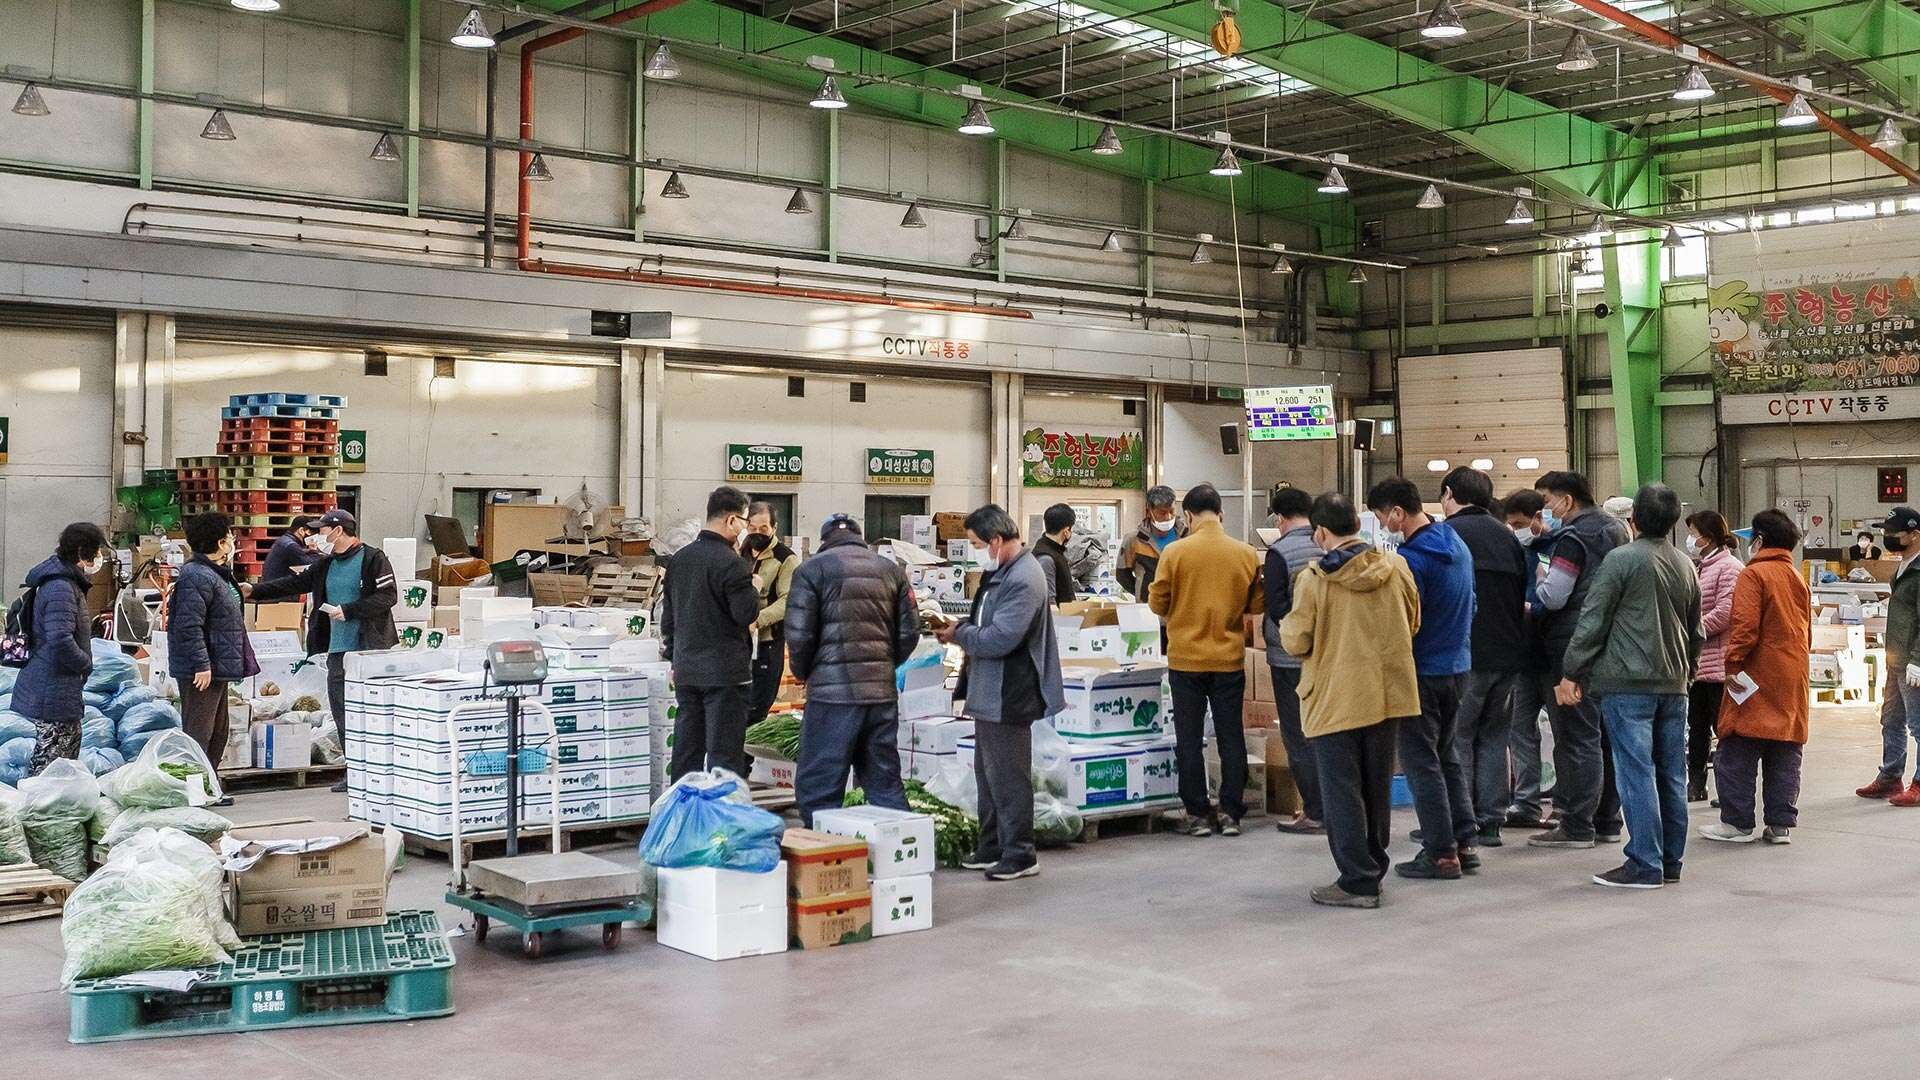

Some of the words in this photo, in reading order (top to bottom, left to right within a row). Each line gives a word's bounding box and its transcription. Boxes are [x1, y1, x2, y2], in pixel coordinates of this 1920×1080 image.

[1762, 284, 1894, 325] 주형농산
[1728, 364, 1803, 382] 주문전화:
[1308, 396, 1322, 404] 251
[1768, 399, 1833, 416] CCTV
[1839, 395, 1890, 413] 작동중
[347, 444, 362, 455] 213
[1043, 432, 1121, 468] 주형농산
[746, 455, 787, 472] 강원농산
[884, 458, 919, 473] 대성상회
[921, 461, 932, 471] 216
[894, 847, 918, 863] 오이
[281, 902, 336, 924] 순쌀떡
[891, 905, 915, 921] 오이
